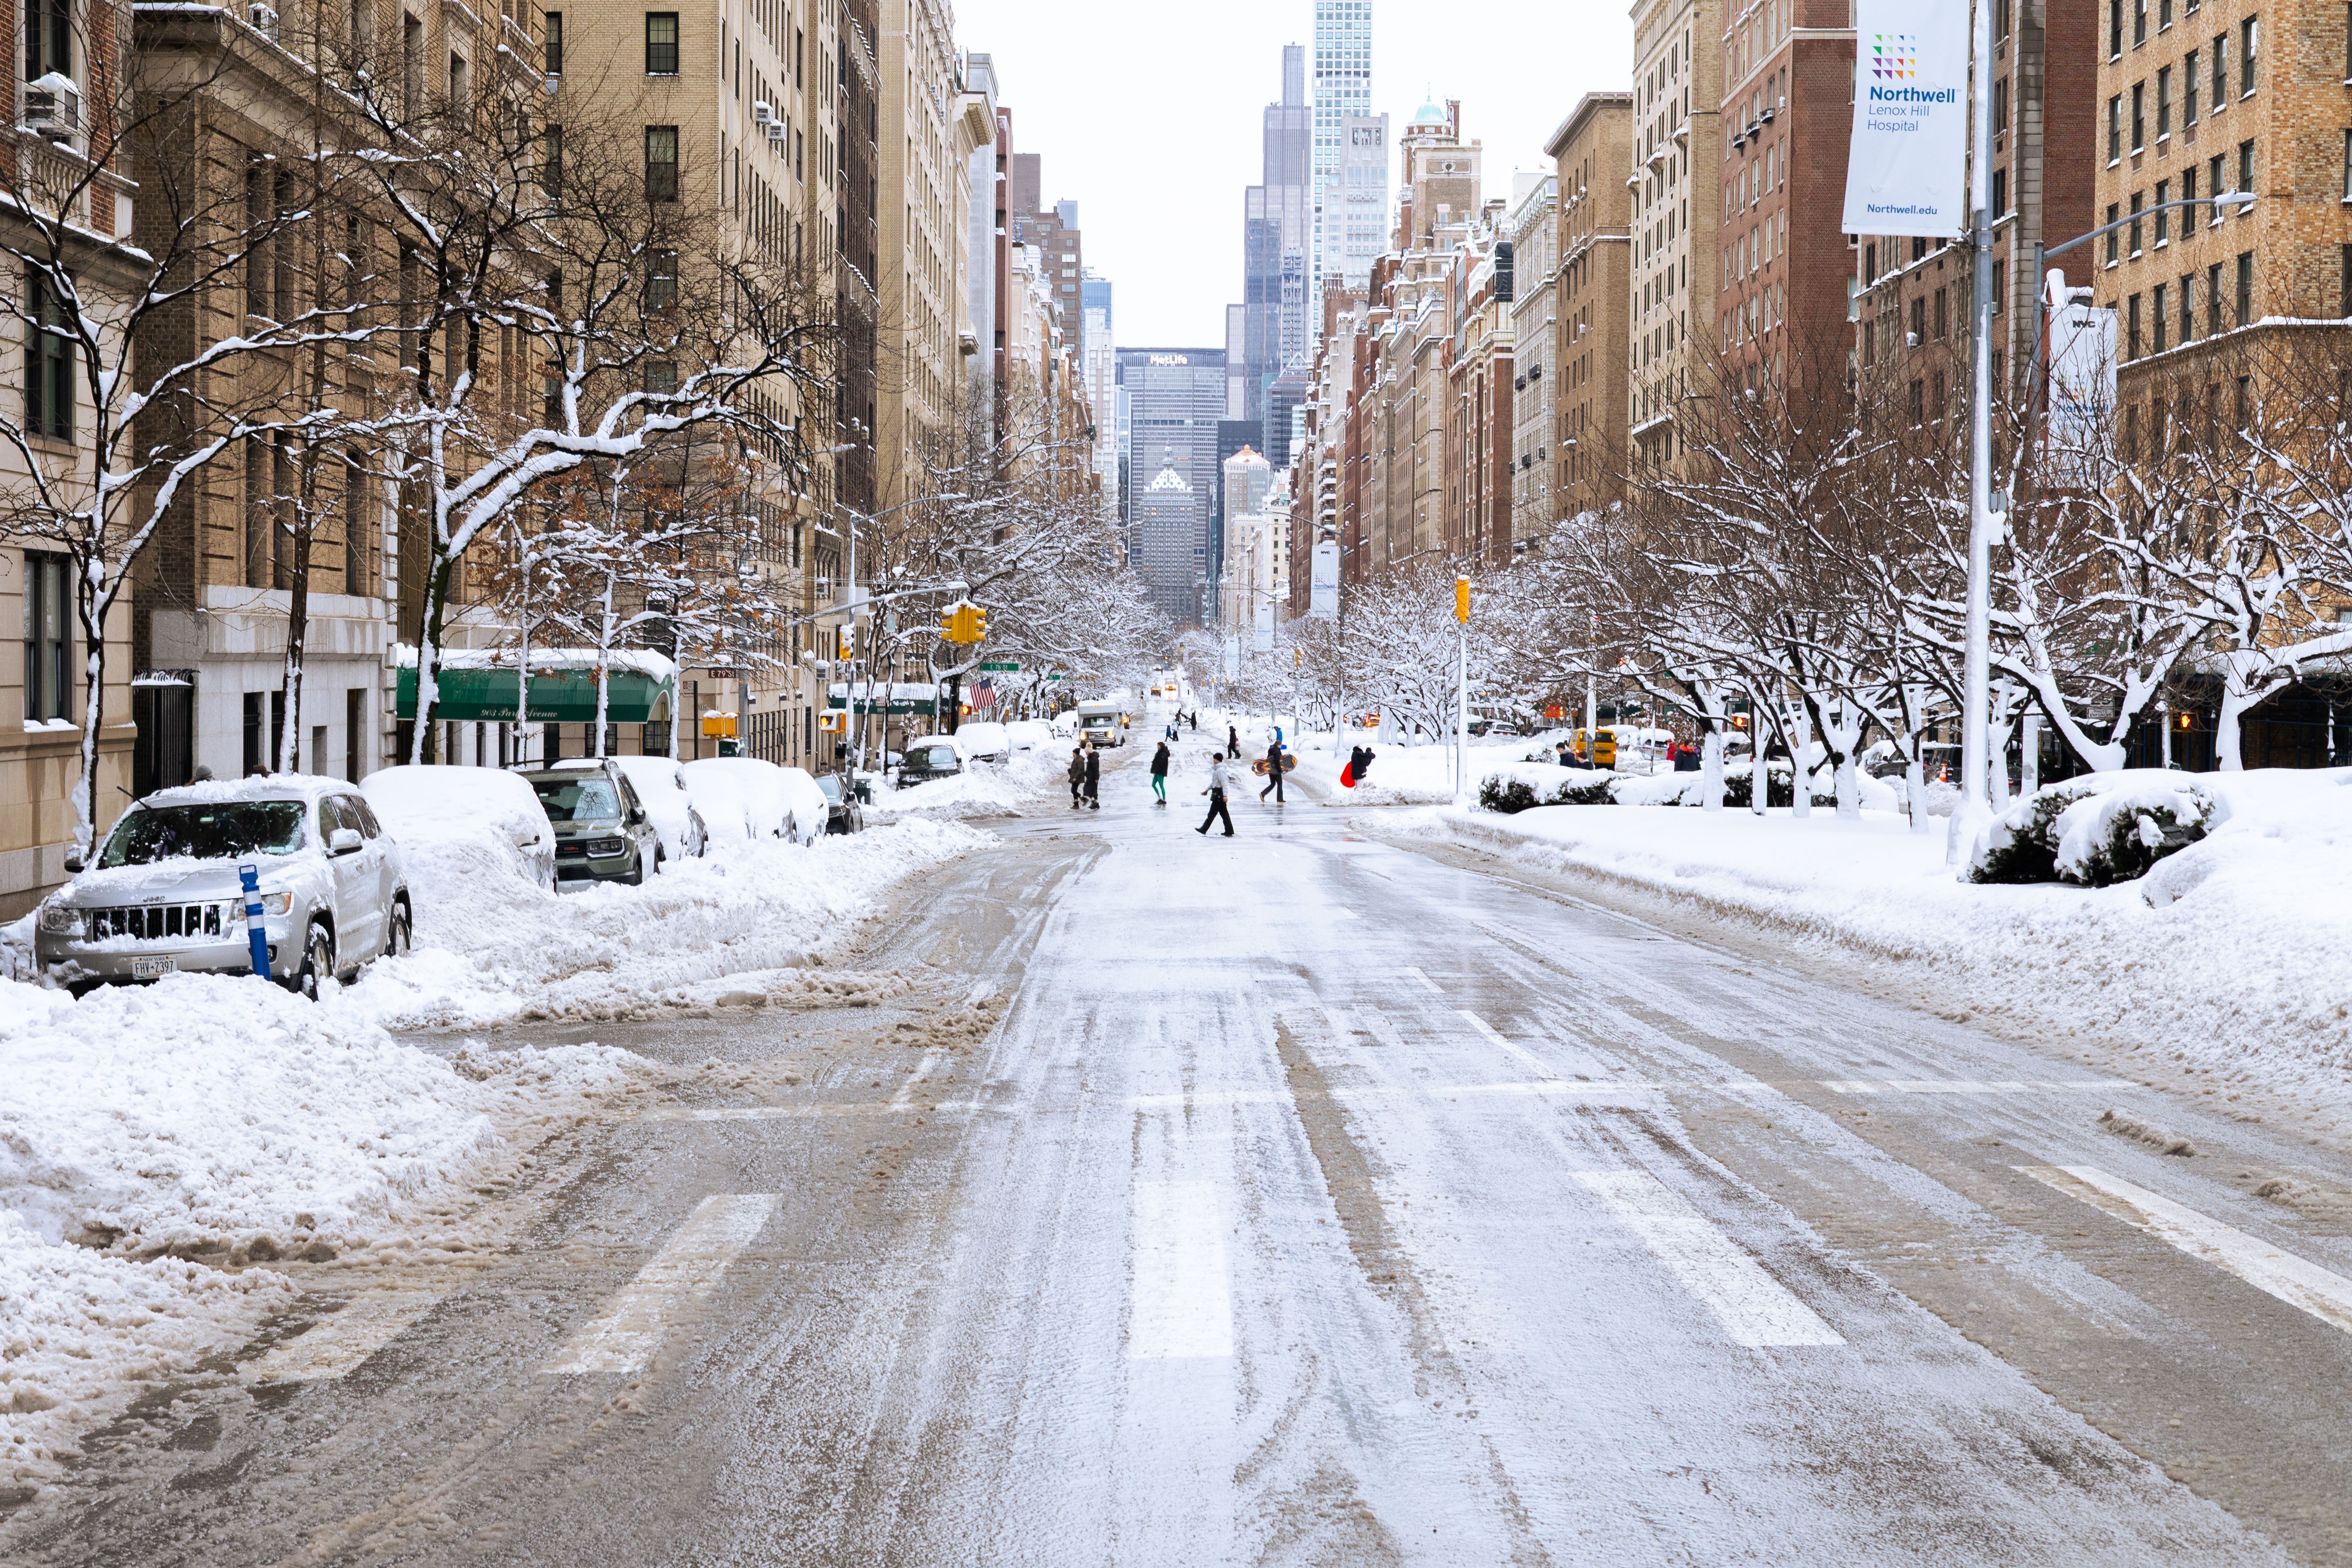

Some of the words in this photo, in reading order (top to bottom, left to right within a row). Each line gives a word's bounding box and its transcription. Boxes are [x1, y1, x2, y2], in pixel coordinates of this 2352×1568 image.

[1870, 86, 1955, 103] Northwell
[1869, 104, 1906, 116] Lenox
[1911, 105, 1930, 116] Hill
[1868, 120, 1918, 133] Hospital
[1867, 204, 1937, 214] Northwell.edu
[1150, 354, 1187, 365] MetLife
[527, 708, 558, 718] Avenue
